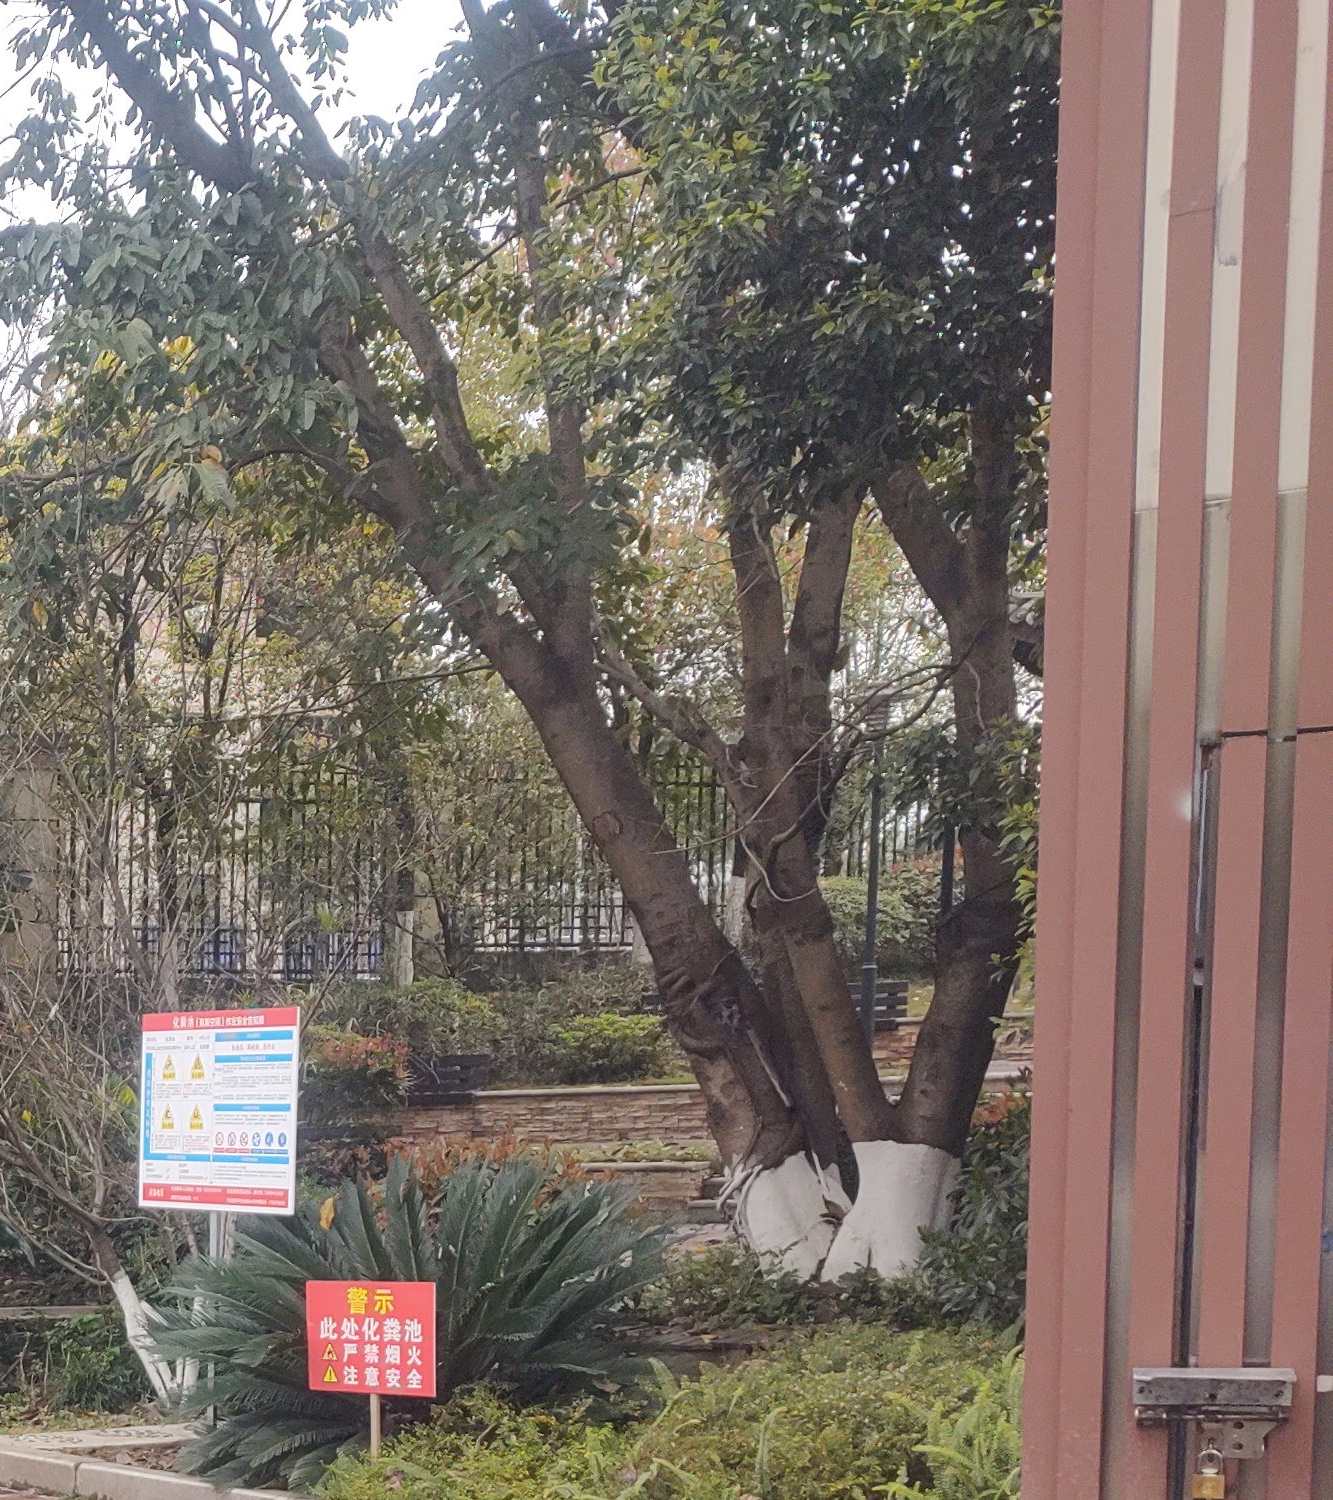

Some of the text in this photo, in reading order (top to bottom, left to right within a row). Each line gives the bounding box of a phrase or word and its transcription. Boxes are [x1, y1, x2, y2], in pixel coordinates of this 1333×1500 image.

[346, 1287, 394, 1314] 警示
[320, 1317, 423, 1342] 此处化粪池
[343, 1343, 422, 1365] 严禁烟火
[343, 1366, 423, 1388] 注意安全
